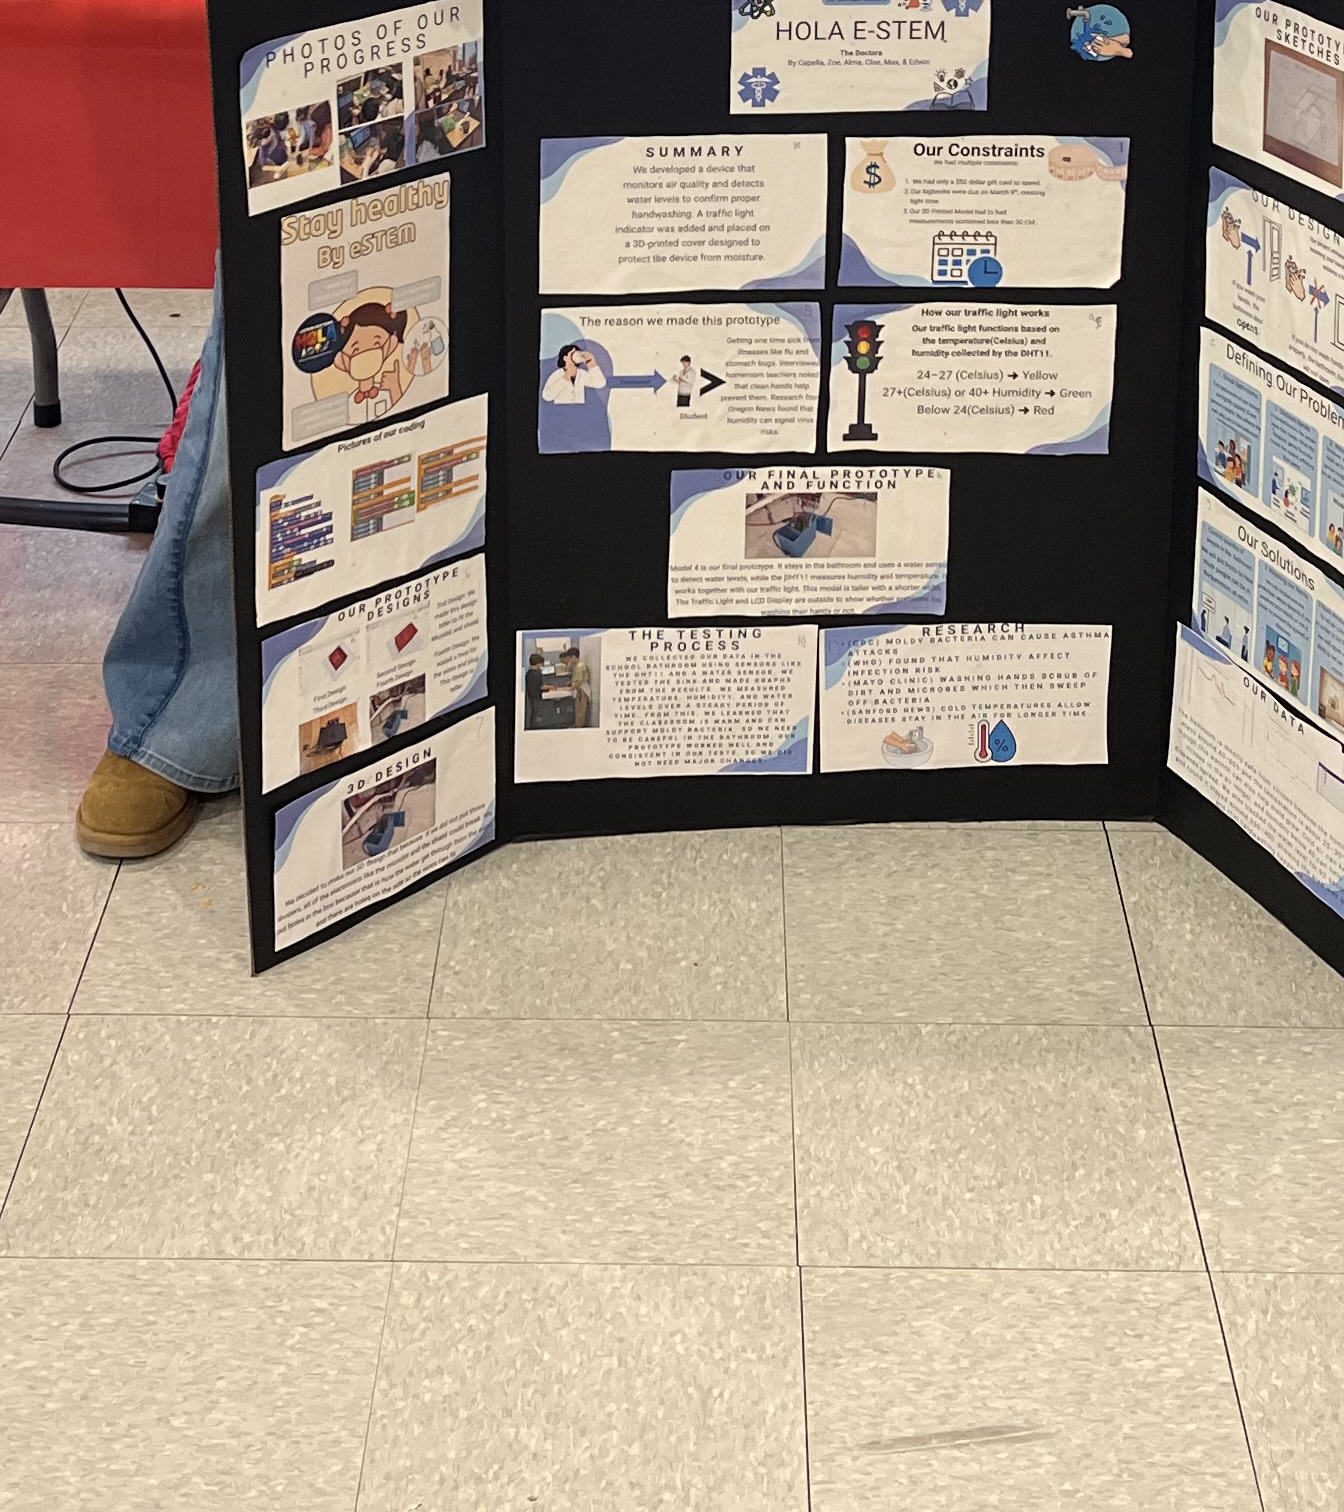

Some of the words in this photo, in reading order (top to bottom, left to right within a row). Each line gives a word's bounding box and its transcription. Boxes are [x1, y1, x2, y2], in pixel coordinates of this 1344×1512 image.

[1255, 6, 1278, 26] OUR
[265, 30, 362, 69] PHOTOS
[376, 19, 403, 40] OF
[417, 6, 461, 30] OUR
[775, 20, 844, 41] HOLA
[853, 19, 946, 41] E-STEM
[1276, 28, 1341, 66] SKETCHES
[304, 33, 427, 79] PROGRESS
[645, 145, 745, 158] SUMMARY
[913, 142, 944, 158] Our
[948, 142, 1046, 158] Constraints
[633, 165, 647, 173] We
[649, 165, 696, 175] developed
[706, 164, 735, 173] device
[737, 163, 756, 173] that
[622, 180, 663, 189] monitors
[665, 180, 677, 188] air
[680, 179, 709, 190] quality
[712, 179, 728, 188] and
[731, 179, 764, 188] detects
[282, 207, 344, 246] Stay
[349, 179, 450, 228] healthy
[1251, 190, 1280, 214] OUR
[1288, 208, 1341, 247] DESIGN
[317, 244, 345, 269] By
[349, 222, 417, 260] eSTEM
[921, 308, 942, 317] How
[964, 308, 994, 317] traffic
[996, 308, 1018, 319] light
[1020, 309, 1050, 317] works
[579, 316, 602, 327] The
[604, 316, 643, 326] reason
[646, 317, 663, 326] we
[666, 315, 699, 326] made
[702, 315, 723, 326] this
[725, 315, 781, 328] prototype
[929, 324, 955, 333] traffic
[957, 324, 976, 334] light
[978, 324, 1019, 333] functions
[1021, 325, 1047, 333] based
[922, 337, 936, 345] the
[1030, 337, 1046, 345] and
[911, 349, 949, 358] humidity
[951, 349, 990, 357] collected
[991, 349, 1003, 359] by
[955, 369, 1004, 382] (Celsius)
[1022, 370, 1059, 380] Yellow
[1226, 343, 1273, 387] Defining
[1276, 374, 1298, 398] Our
[954, 389, 965, 397] or
[968, 387, 990, 397] 40+
[992, 387, 1042, 400] Humidity
[1059, 388, 1092, 398] Green
[916, 405, 950, 415] Below
[953, 405, 1015, 417] 24(Celsius)
[1033, 405, 1055, 415] Red
[337, 435, 371, 452] Pictures
[374, 432, 383, 443] of
[384, 428, 397, 439] our
[398, 419, 426, 435] coding
[723, 470, 757, 481] OUR
[768, 470, 820, 480] FINAL
[830, 469, 936, 480] PROTOTYPE
[761, 481, 795, 490] AND
[806, 479, 898, 490] FUNCTION
[1237, 524, 1259, 550] Our
[1261, 540, 1316, 592] Solutions
[337, 603, 366, 622] OUR
[374, 567, 460, 608] PROTOTYPE
[367, 589, 431, 621] DESIGNS
[629, 629, 665, 641] THE
[677, 628, 763, 640] TESTING
[922, 623, 1026, 637] RESEARCH
[650, 640, 741, 652] PROCESS
[1243, 676, 1267, 704] OUR
[1273, 702, 1306, 736] DATA
[346, 779, 365, 795] 3D
[374, 747, 432, 783] DESIGN
